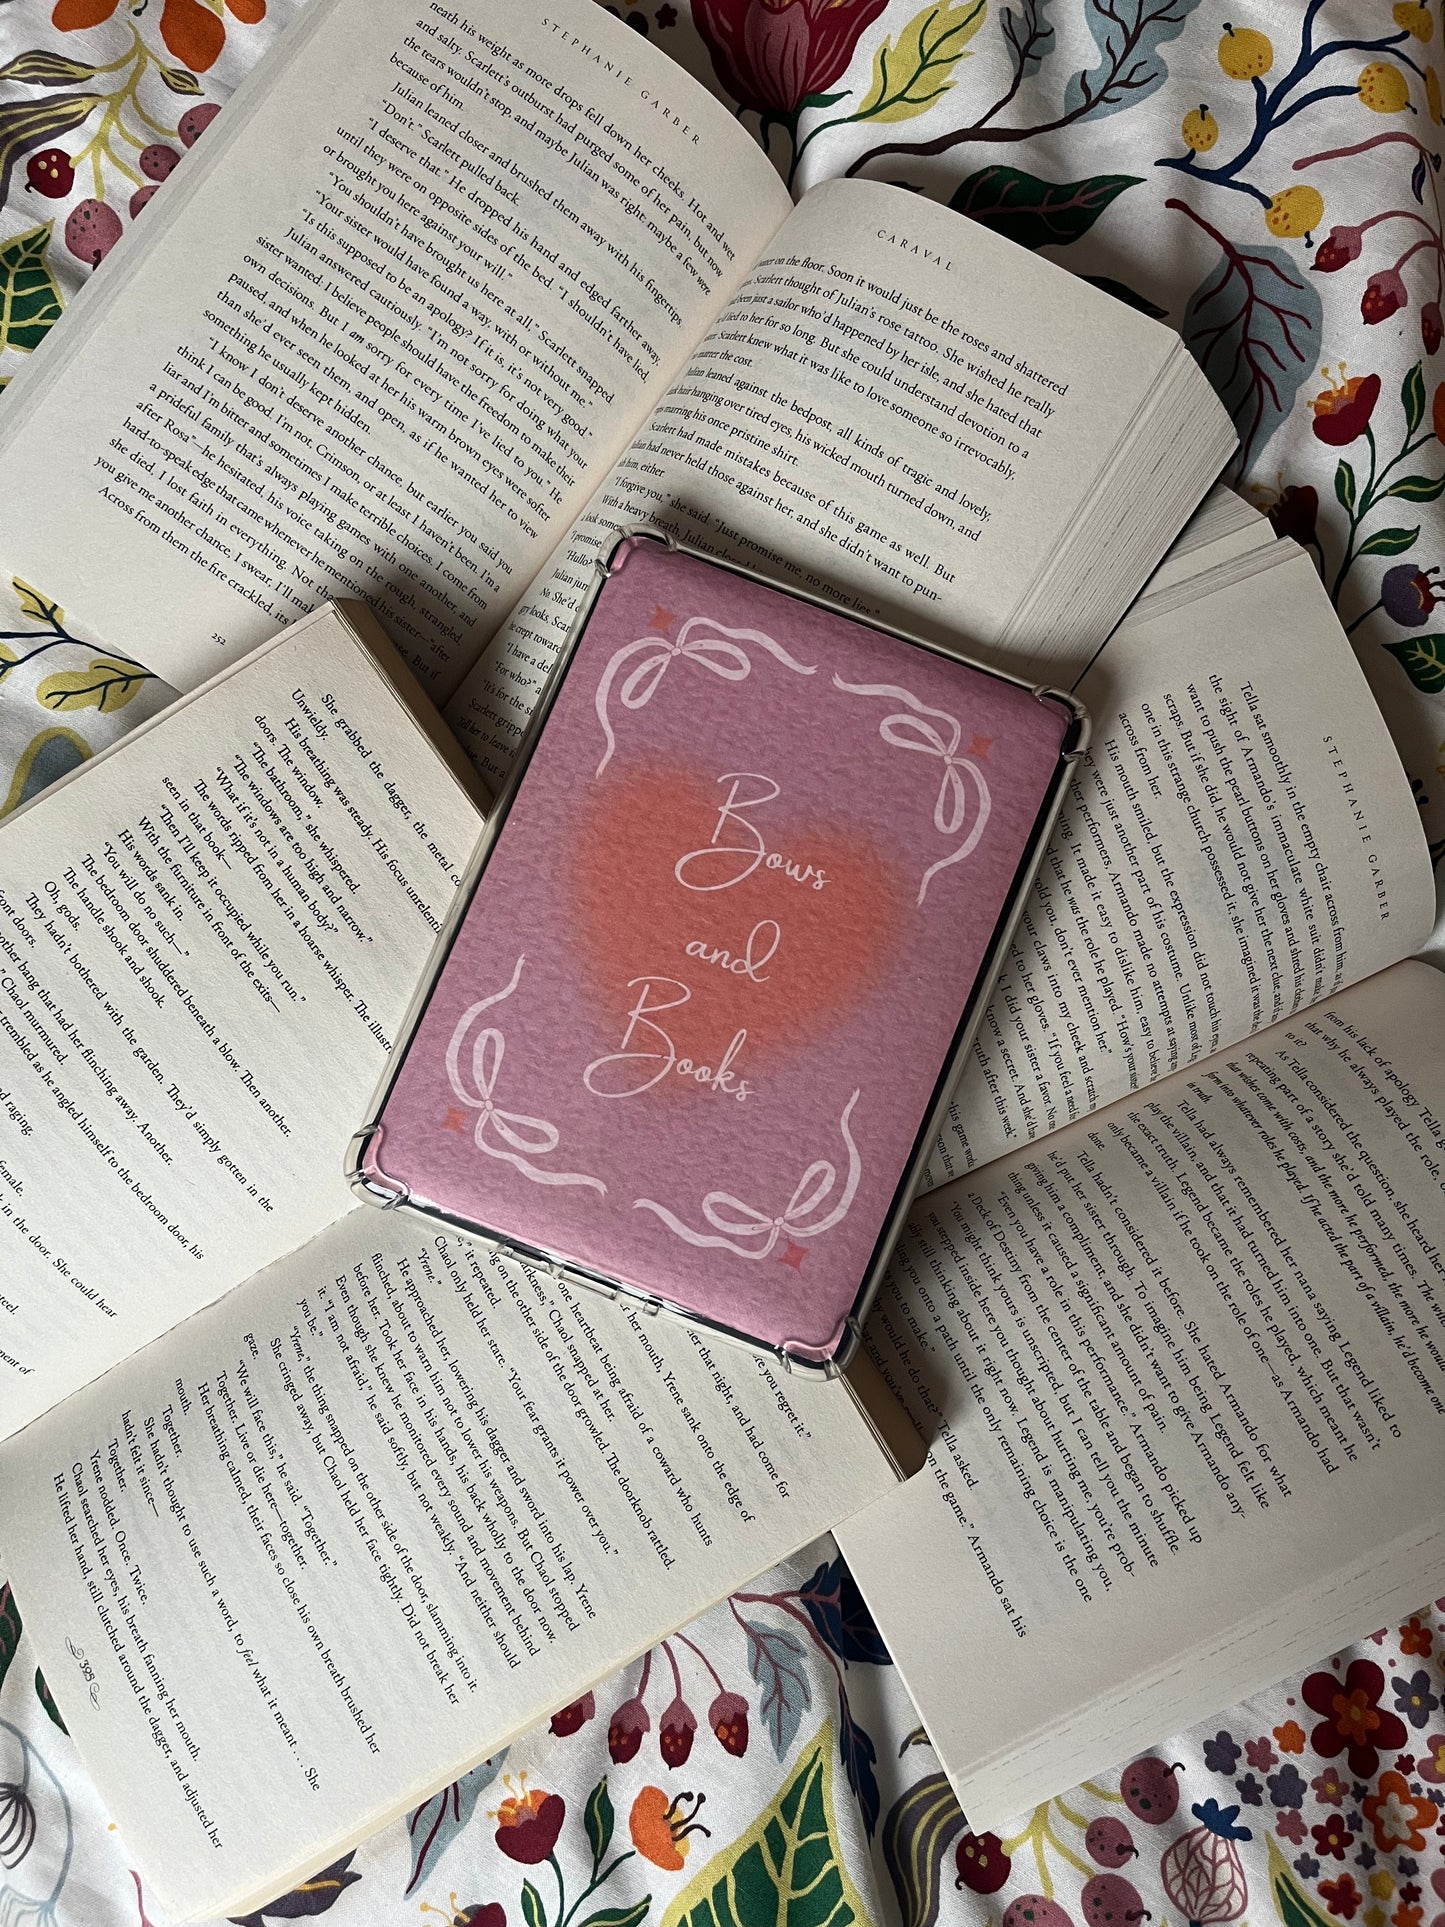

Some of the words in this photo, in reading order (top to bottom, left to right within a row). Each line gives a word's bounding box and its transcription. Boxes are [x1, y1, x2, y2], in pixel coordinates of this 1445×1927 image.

[429, 2, 459, 25] neath
[459, 19, 477, 36] his
[478, 34, 512, 61] weight
[511, 58, 525, 69] as
[524, 67, 553, 89] more
[553, 85, 584, 111] drops
[584, 107, 604, 126] fell
[603, 123, 632, 151] down
[632, 145, 652, 166] her
[652, 166, 685, 201] cheeks.
[687, 197, 707, 223] Hot
[706, 222, 725, 243] and
[722, 241, 735, 261] wet
[541, 18, 633, 86] STEPHANIE
[640, 90, 699, 145] GARBER
[382, 99, 423, 131] “Don’t.”
[420, 129, 461, 162] Scarlett
[458, 159, 496, 186] pulled
[494, 179, 519, 206] back.
[877, 229, 951, 271] CARAVAL
[209, 336, 219, 350] “I
[218, 345, 249, 371] know
[249, 367, 258, 378] I
[258, 375, 285, 399] don’t
[286, 395, 324, 427] deserve
[325, 425, 366, 457] another
[366, 455, 403, 487] chance,
[406, 481, 425, 502] but
[426, 500, 459, 527] earlier
[457, 525, 478, 544] you
[478, 542, 500, 561] said
[495, 558, 513, 575] you
[705, 367, 735, 384] leaned
[733, 379, 768, 398] against
[770, 391, 788, 407] the
[790, 399, 832, 432] bedpost,
[836, 427, 854, 440] all
[853, 433, 884, 458] kinds
[886, 456, 904, 467] of
[902, 463, 933, 487] tragic
[934, 484, 959, 500] and
[958, 493, 991, 522] lovely,
[676, 426, 696, 441] had
[694, 436, 723, 453] made
[723, 449, 771, 477] mistakes
[772, 470, 816, 502] because
[817, 499, 835, 510] of
[833, 506, 855, 525] this
[854, 521, 887, 543] game
[888, 541, 902, 552] as
[905, 548, 930, 569] well.
[933, 563, 956, 583] But
[211, 632, 226, 646] 252
[1118, 712, 1139, 746] across
[1134, 747, 1152, 776] from
[1147, 775, 1162, 799] her.
[1240, 680, 1259, 712] Tella
[1252, 713, 1266, 730] sat
[1261, 731, 1292, 784] smoothly
[1285, 785, 1297, 800] in
[1292, 801, 1306, 821] the
[1300, 823, 1320, 859] empty
[1315, 862, 1332, 891] chair
[1324, 893, 1339, 926] across
[233, 754, 250, 781] “The
[247, 780, 282, 825] windows
[278, 825, 294, 842] are
[291, 842, 307, 860] too
[303, 857, 326, 885] high
[321, 884, 343, 905] and
[336, 904, 373, 942] narrow.”
[252, 741, 268, 769] “The
[265, 766, 312, 821] bathroom,”
[305, 823, 321, 842] she
[319, 841, 361, 895] whispered.
[675, 772, 832, 892] Bows
[1322, 735, 1371, 843] STEPHANIE
[1368, 854, 1389, 920] GARBER
[44, 881, 60, 904] Oh,
[55, 904, 80, 931] gods.
[117, 828, 135, 851] His
[133, 850, 158, 882] words
[154, 882, 176, 907] sank
[171, 904, 183, 922] in.
[81, 853, 98, 877] The
[95, 874, 130, 922] bedroom
[128, 922, 149, 946] door
[145, 946, 189, 998] shuddered
[182, 994, 216, 1037] beneath
[212, 1037, 220, 1045] a
[218, 1042, 240, 1072] blow.
[239, 1069, 261, 1098] Then
[258, 1098, 291, 1137] another.
[685, 919, 782, 984] and
[583, 976, 756, 1102] Books
[434, 1235, 457, 1269] Chaol
[450, 1270, 467, 1293] only
[1177, 1099, 1197, 1122] Tella
[1193, 1119, 1216, 1140] had
[1208, 1140, 1237, 1174] always
[1233, 1175, 1287, 1247] remembered
[1279, 1246, 1298, 1268] her
[1293, 1270, 1316, 1301] nana
[1313, 1302, 1342, 1342] saying
[1338, 1340, 1375, 1388] Legend
[1367, 1387, 1396, 1422] liked
[1389, 1423, 1401, 1438] to
[462, 1292, 483, 1319] held
[475, 1317, 491, 1338] her
[487, 1339, 505, 1368] stare.
[507, 1367, 527, 1400] “Your
[522, 1401, 540, 1422] fear
[997, 1191, 1016, 1219] “Even
[1009, 1218, 1028, 1239] you
[1024, 1237, 1044, 1265] have
[1040, 1266, 1049, 1275] a
[1045, 1275, 1064, 1298] role
[1059, 1298, 1071, 1313] in
[1068, 1313, 1085, 1337] this
[1078, 1338, 1136, 1417] performance.”
[1129, 1424, 1168, 1481] Armando
[1160, 1483, 1196, 1525] picked
[1188, 1526, 1202, 1543] up
[236, 1359, 249, 1386] “We
[243, 1386, 259, 1409] will
[251, 1409, 266, 1432] face
[262, 1433, 284, 1460] this,”
[276, 1462, 287, 1479] he
[283, 1479, 303, 1506] said.
[301, 1505, 338, 1566] “Together.”
[532, 1424, 559, 1458] grants
[555, 1457, 565, 1469] it
[557, 1469, 585, 1503] power
[90, 1448, 103, 1484] Yrene
[98, 1484, 120, 1530] nodded.
[115, 1530, 131, 1566] Once.
[129, 1564, 147, 1605] Twice.
[581, 1505, 599, 1528] over
[591, 1529, 619, 1555] you.”
[934, 1468, 949, 1490] the
[942, 1491, 974, 1529] game.”
[967, 1536, 1004, 1595] Armando
[1000, 1597, 1015, 1616] sat
[1011, 1615, 1026, 1638] his
